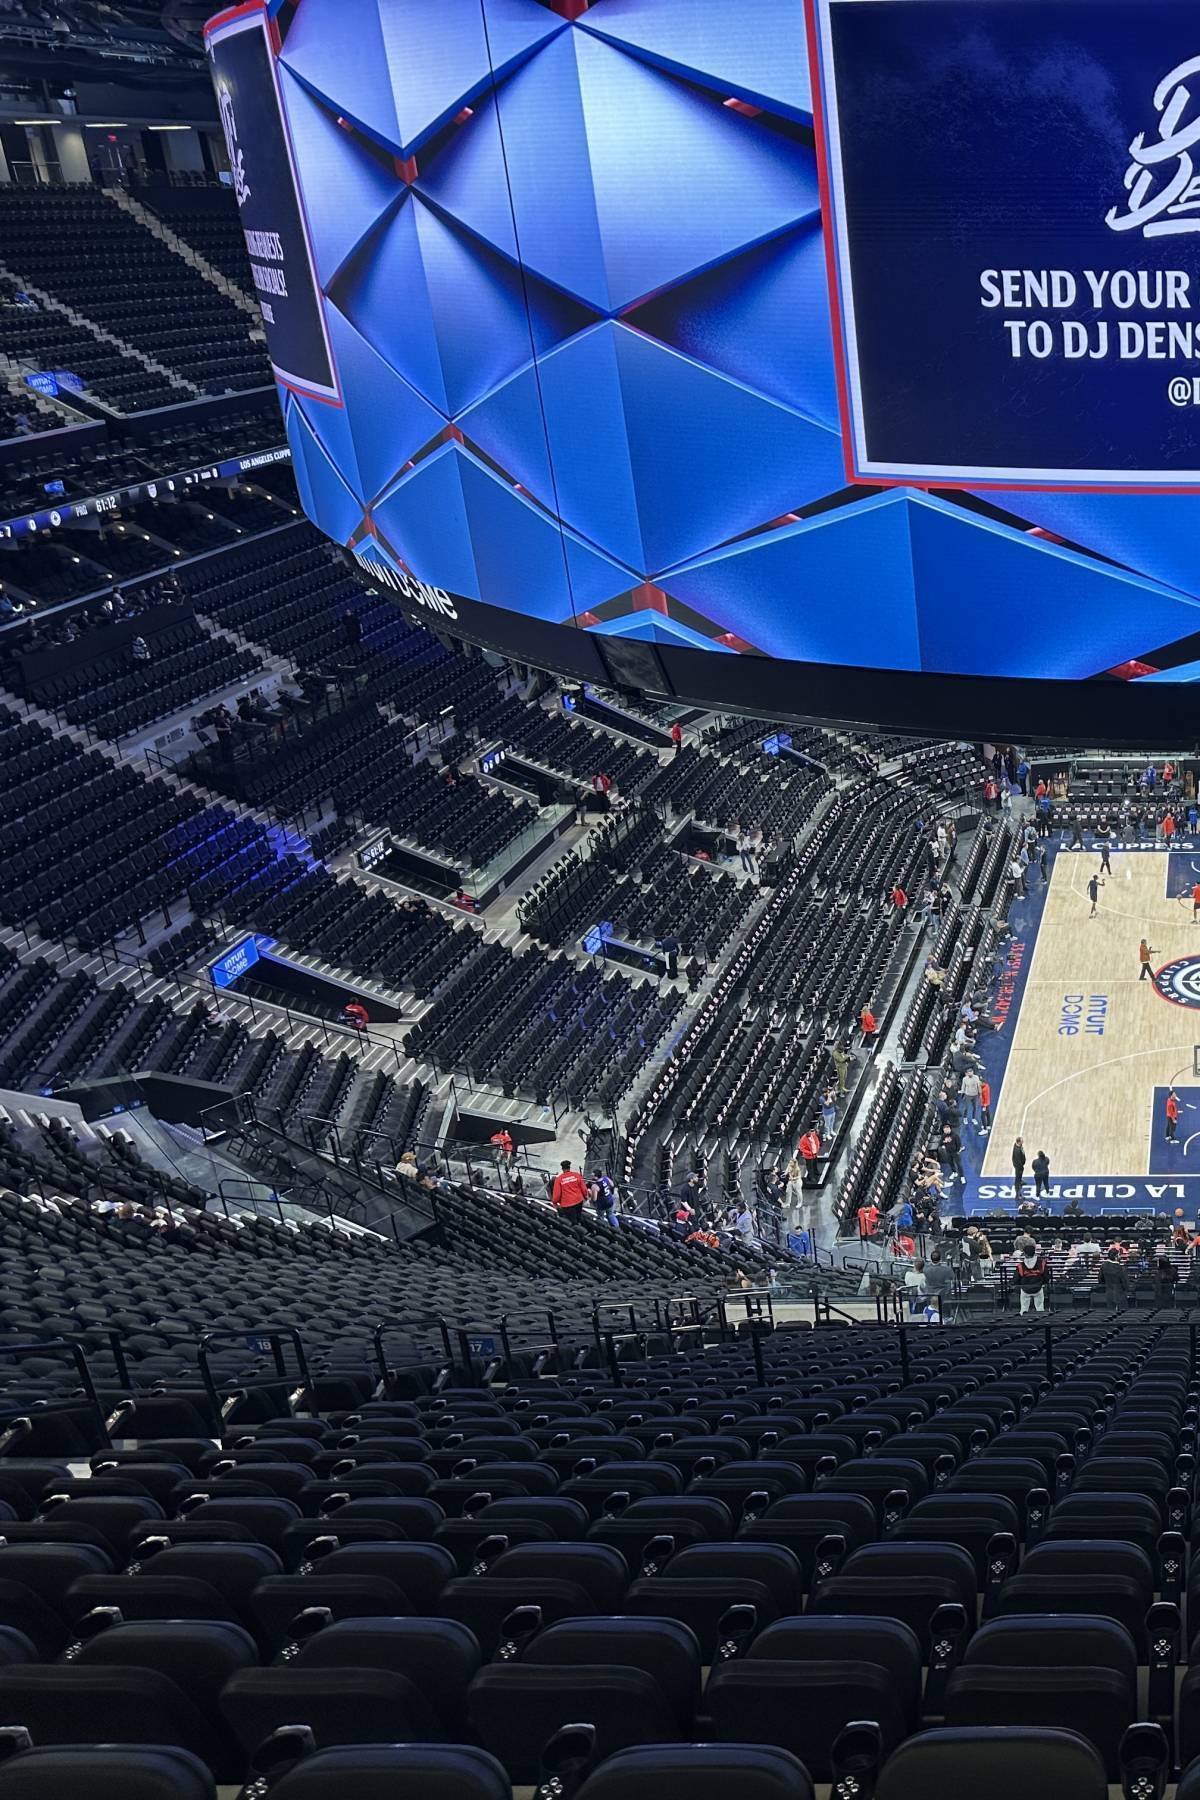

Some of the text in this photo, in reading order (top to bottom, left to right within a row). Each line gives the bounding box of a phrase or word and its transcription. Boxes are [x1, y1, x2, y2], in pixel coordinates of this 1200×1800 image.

[980, 269, 1076, 309] SEND
[1082, 269, 1190, 309] YOUR
[1004, 321, 1053, 359] TO
[1064, 321, 1109, 359] DJ
[240, 459, 251, 470] LOS
[251, 453, 274, 467] ANGELES
[96, 496, 117, 513] 61:12
[1092, 842, 1194, 850] CLIPPERS
[1160, 961, 1189, 1004] CLIPPERS
[978, 1184, 1185, 1199] LA CLIPPERS
[257, 1341, 272, 1350] 19
